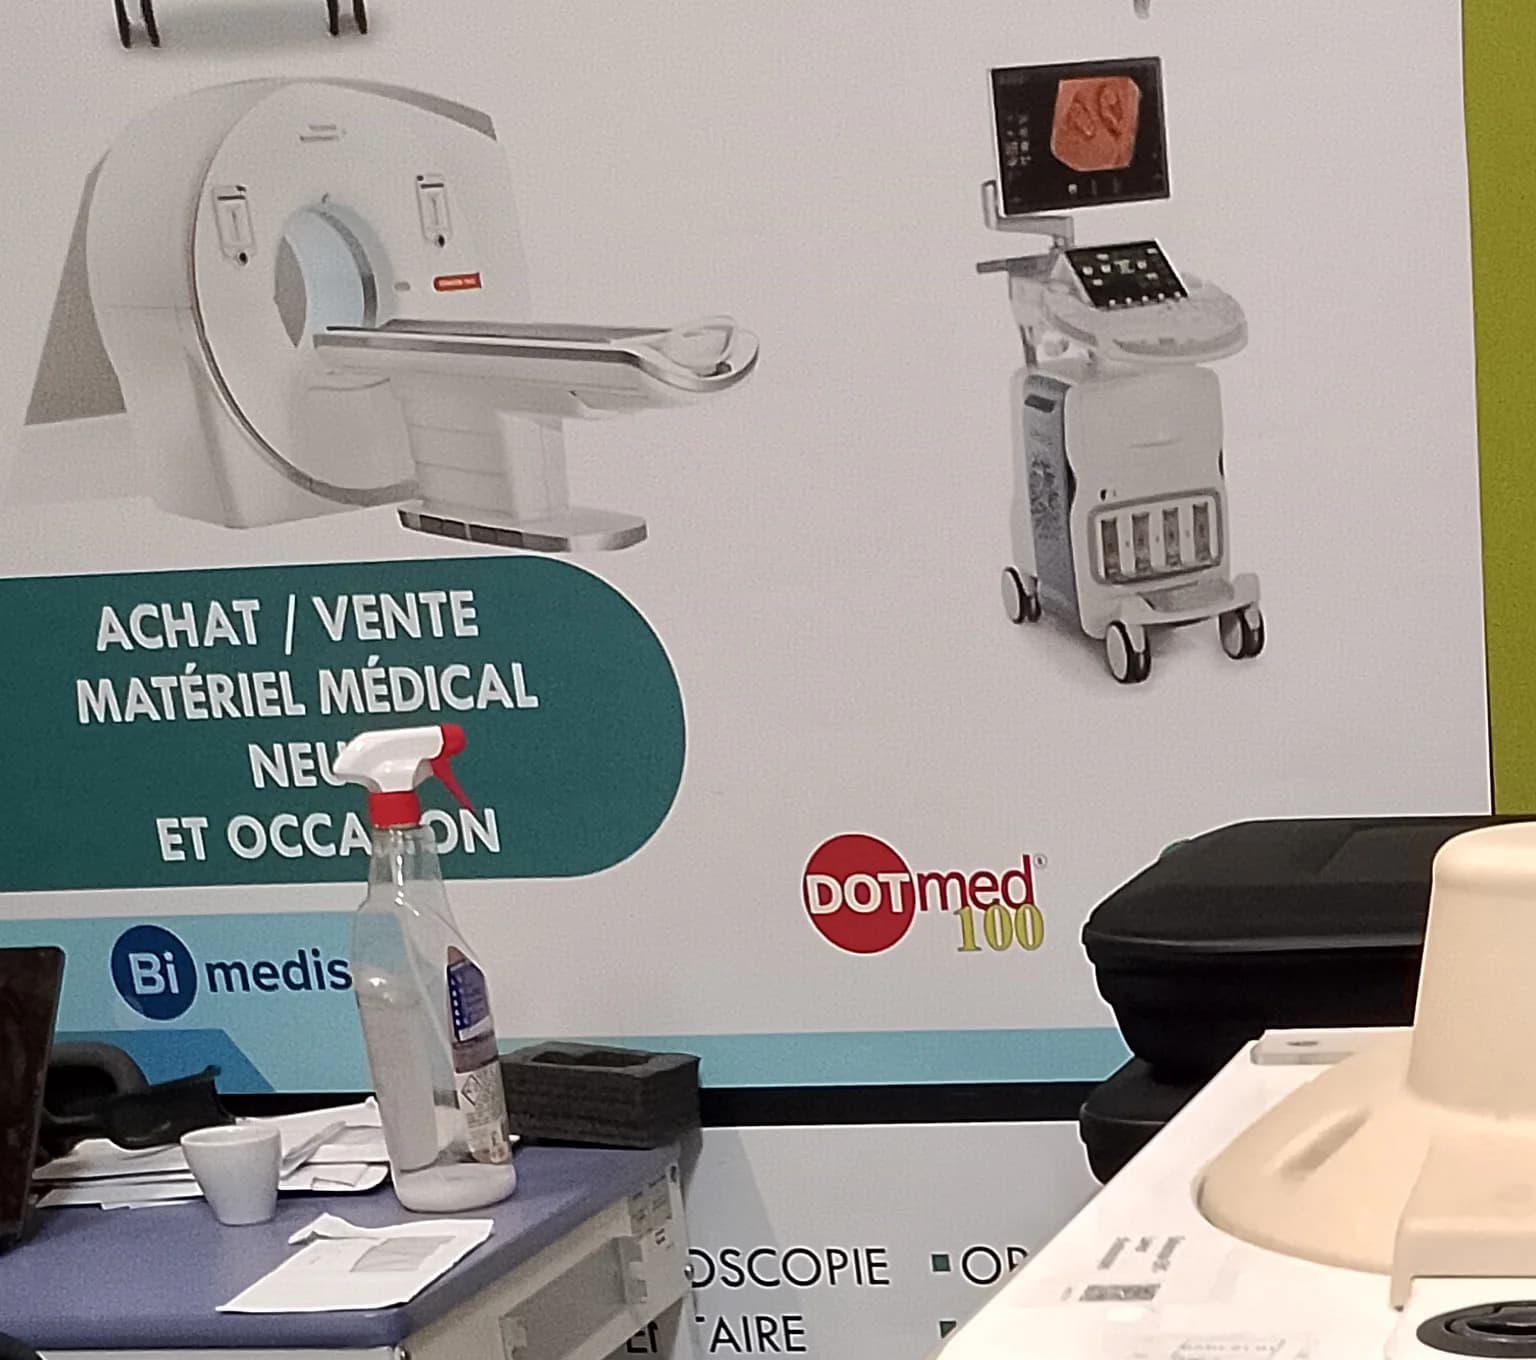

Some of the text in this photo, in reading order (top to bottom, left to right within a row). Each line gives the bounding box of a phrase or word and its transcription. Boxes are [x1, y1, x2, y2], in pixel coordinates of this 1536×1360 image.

[97, 599, 259, 651] ACHAT
[313, 590, 480, 642] VENTE
[76, 655, 539, 724] MATÉRIEL MÉDICAL
[249, 742, 349, 789] NEU
[156, 808, 500, 861] ET OCCAON
[806, 854, 1035, 913] DOTmed
[953, 904, 1045, 952] 100
[129, 949, 353, 995] Bi medis
